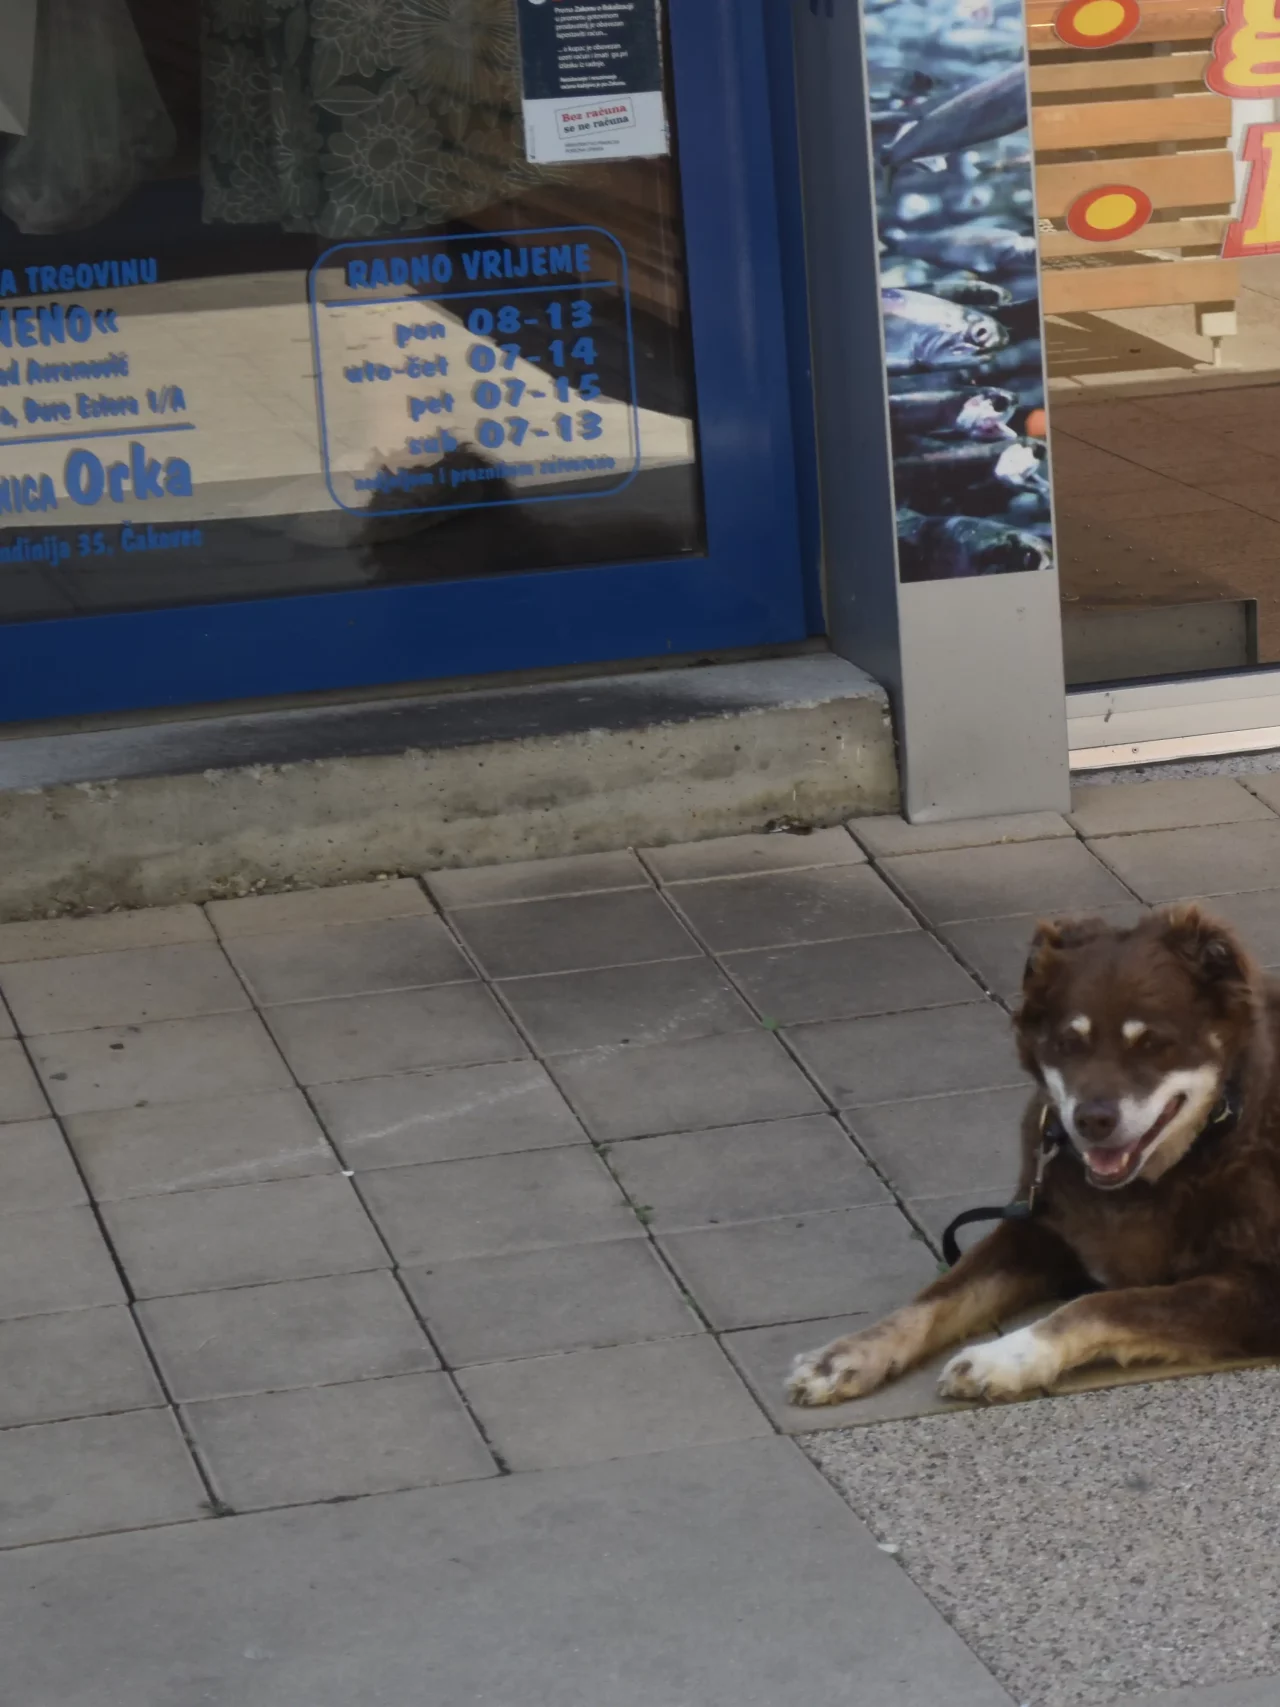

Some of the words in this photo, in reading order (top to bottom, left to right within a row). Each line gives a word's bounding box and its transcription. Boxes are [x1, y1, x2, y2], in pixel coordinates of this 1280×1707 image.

[562, 113, 583, 122] Bez
[586, 105, 627, 118] računa
[578, 122, 590, 131] ne
[593, 116, 629, 128] računa
[25, 257, 158, 294] TRGOVINU
[347, 257, 453, 289] RADNO
[462, 243, 592, 281] VRIJEME
[395, 321, 447, 348] pon
[345, 355, 449, 383] uto-čet
[409, 390, 455, 422] pet
[407, 426, 458, 455] sub
[63, 440, 193, 506] Orka
[121, 519, 203, 553] Čakovec
